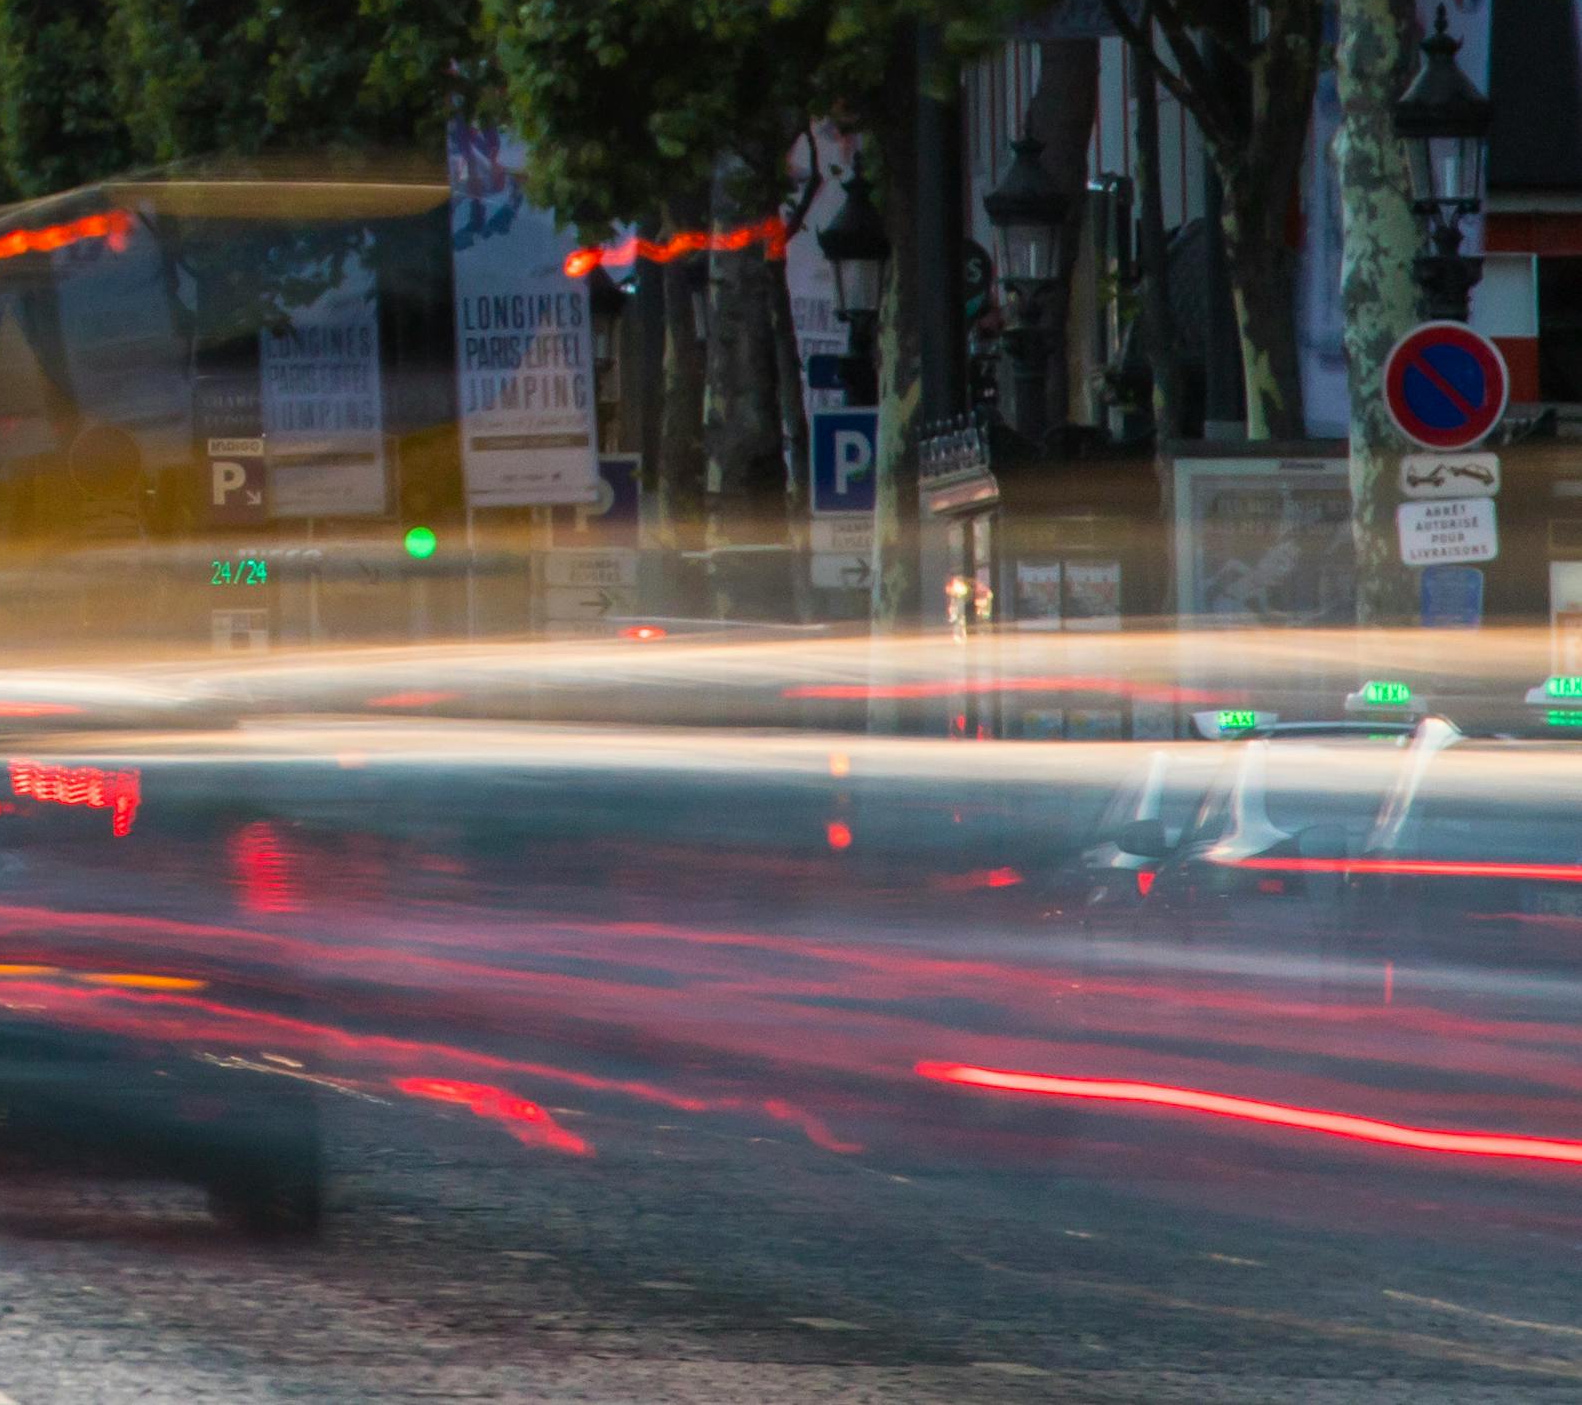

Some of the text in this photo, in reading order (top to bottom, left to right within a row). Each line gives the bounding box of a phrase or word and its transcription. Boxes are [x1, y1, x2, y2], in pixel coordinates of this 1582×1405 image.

[464, 293, 582, 331] LONGINES
[465, 333, 582, 371] PARIS EIFFEL
[466, 373, 587, 413] JUMPING
[835, 429, 871, 495] P
[212, 462, 246, 505] P
[1411, 545, 1487, 560] LIVRAISONS
[1431, 533, 1465, 543] POUR
[211, 559, 268, 585] 24/24
